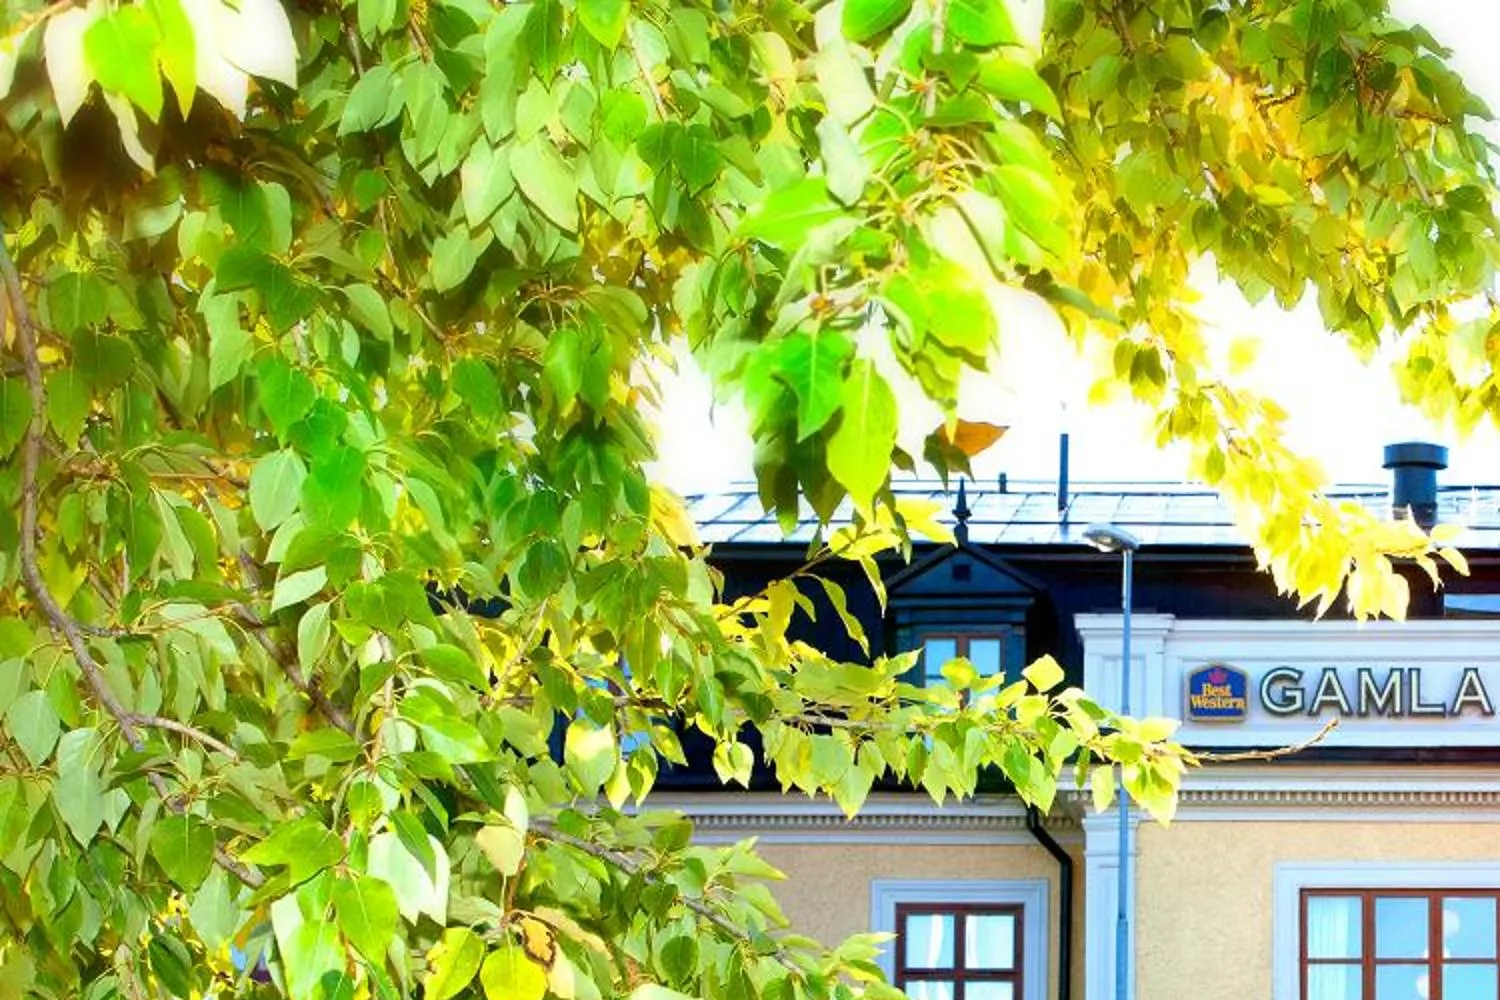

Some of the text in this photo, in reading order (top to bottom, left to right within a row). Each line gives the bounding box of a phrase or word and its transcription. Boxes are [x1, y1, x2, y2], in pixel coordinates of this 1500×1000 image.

[1202, 683, 1232, 697] Best
[1259, 666, 1496, 717] GAMLA
[1191, 695, 1247, 709] Western
